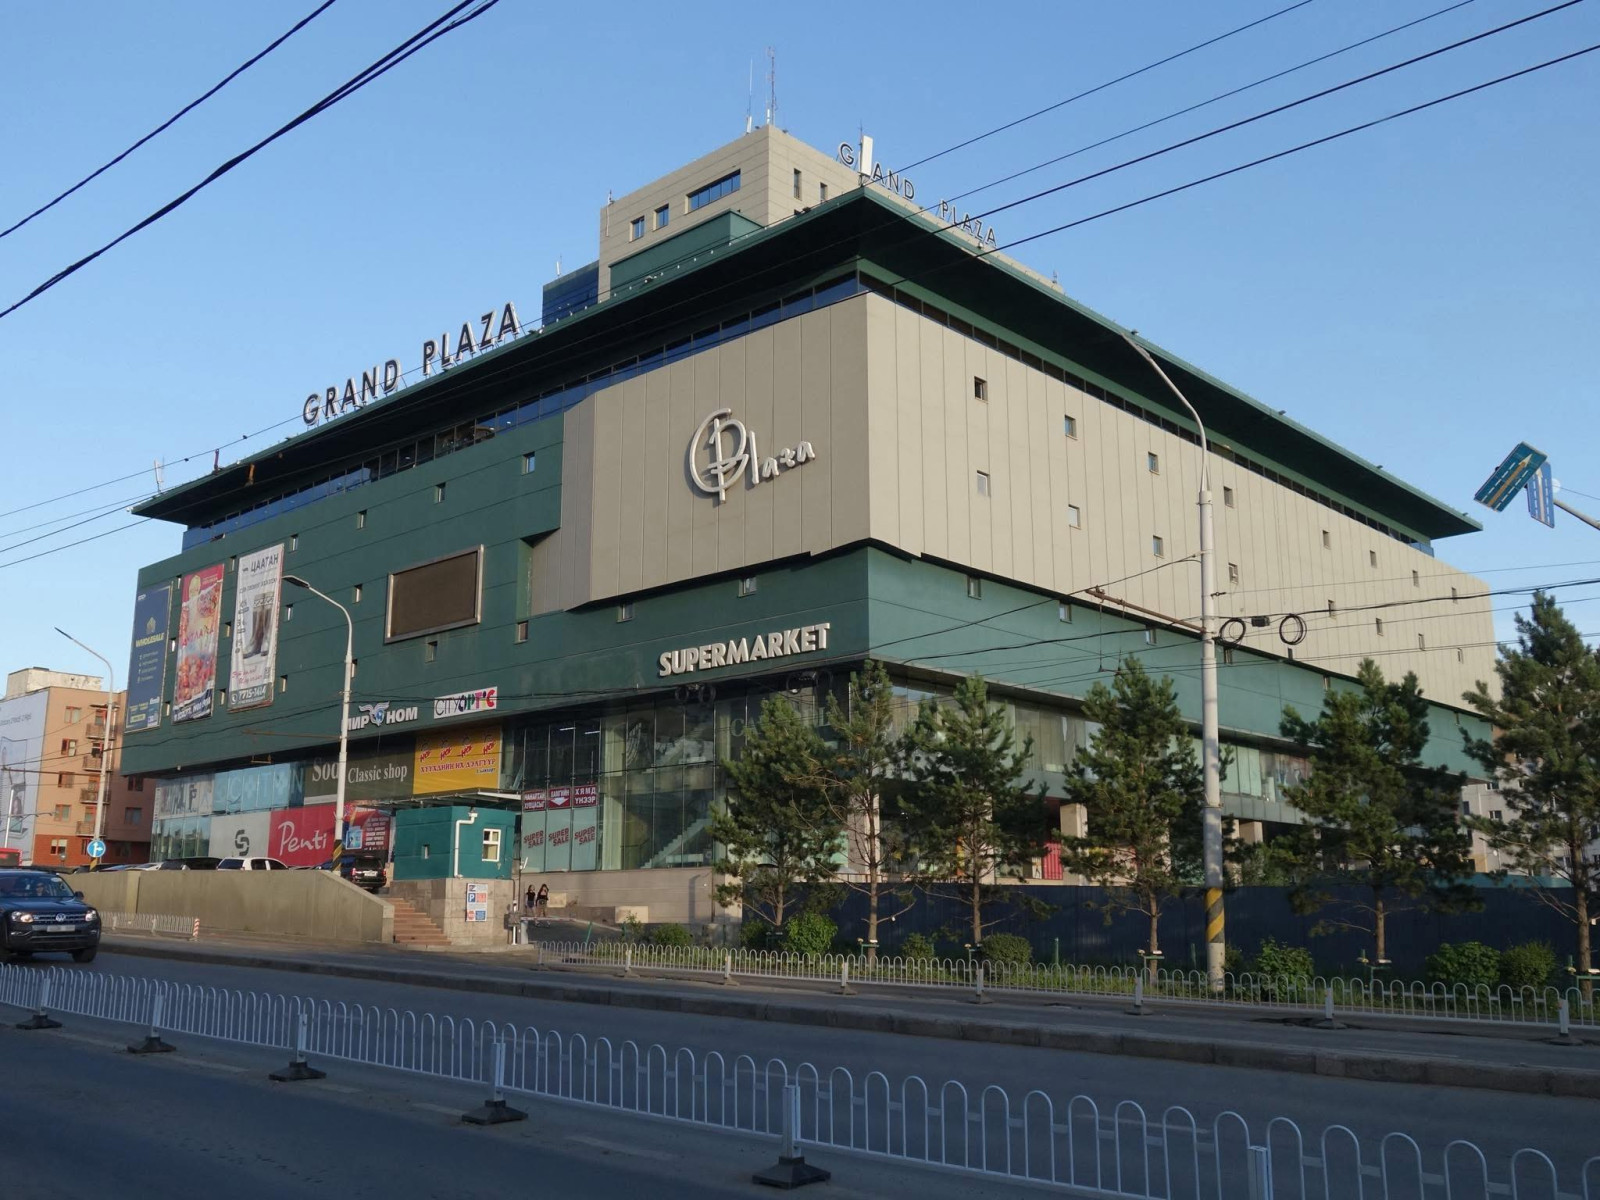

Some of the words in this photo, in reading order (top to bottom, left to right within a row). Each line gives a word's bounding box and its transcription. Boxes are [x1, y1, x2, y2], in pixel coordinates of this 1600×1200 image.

[838, 141, 915, 200] GAND
[938, 199, 998, 248] PLAZA
[302, 358, 402, 427] GRAND
[423, 300, 520, 378] PLAZA
[659, 622, 831, 678] SUPERMARKET
[386, 706, 419, 724] НОМ
[348, 765, 381, 783] Classic
[384, 763, 408, 782] shop
[575, 786, 597, 795] ХЯМД
[278, 821, 328, 857] Penti
[523, 830, 544, 844] SUPER
[549, 827, 570, 841] SUPER
[574, 826, 596, 840] SUPER
[579, 834, 596, 845] SALE
[528, 838, 544, 849] SALE
[553, 836, 569, 847] SALE
